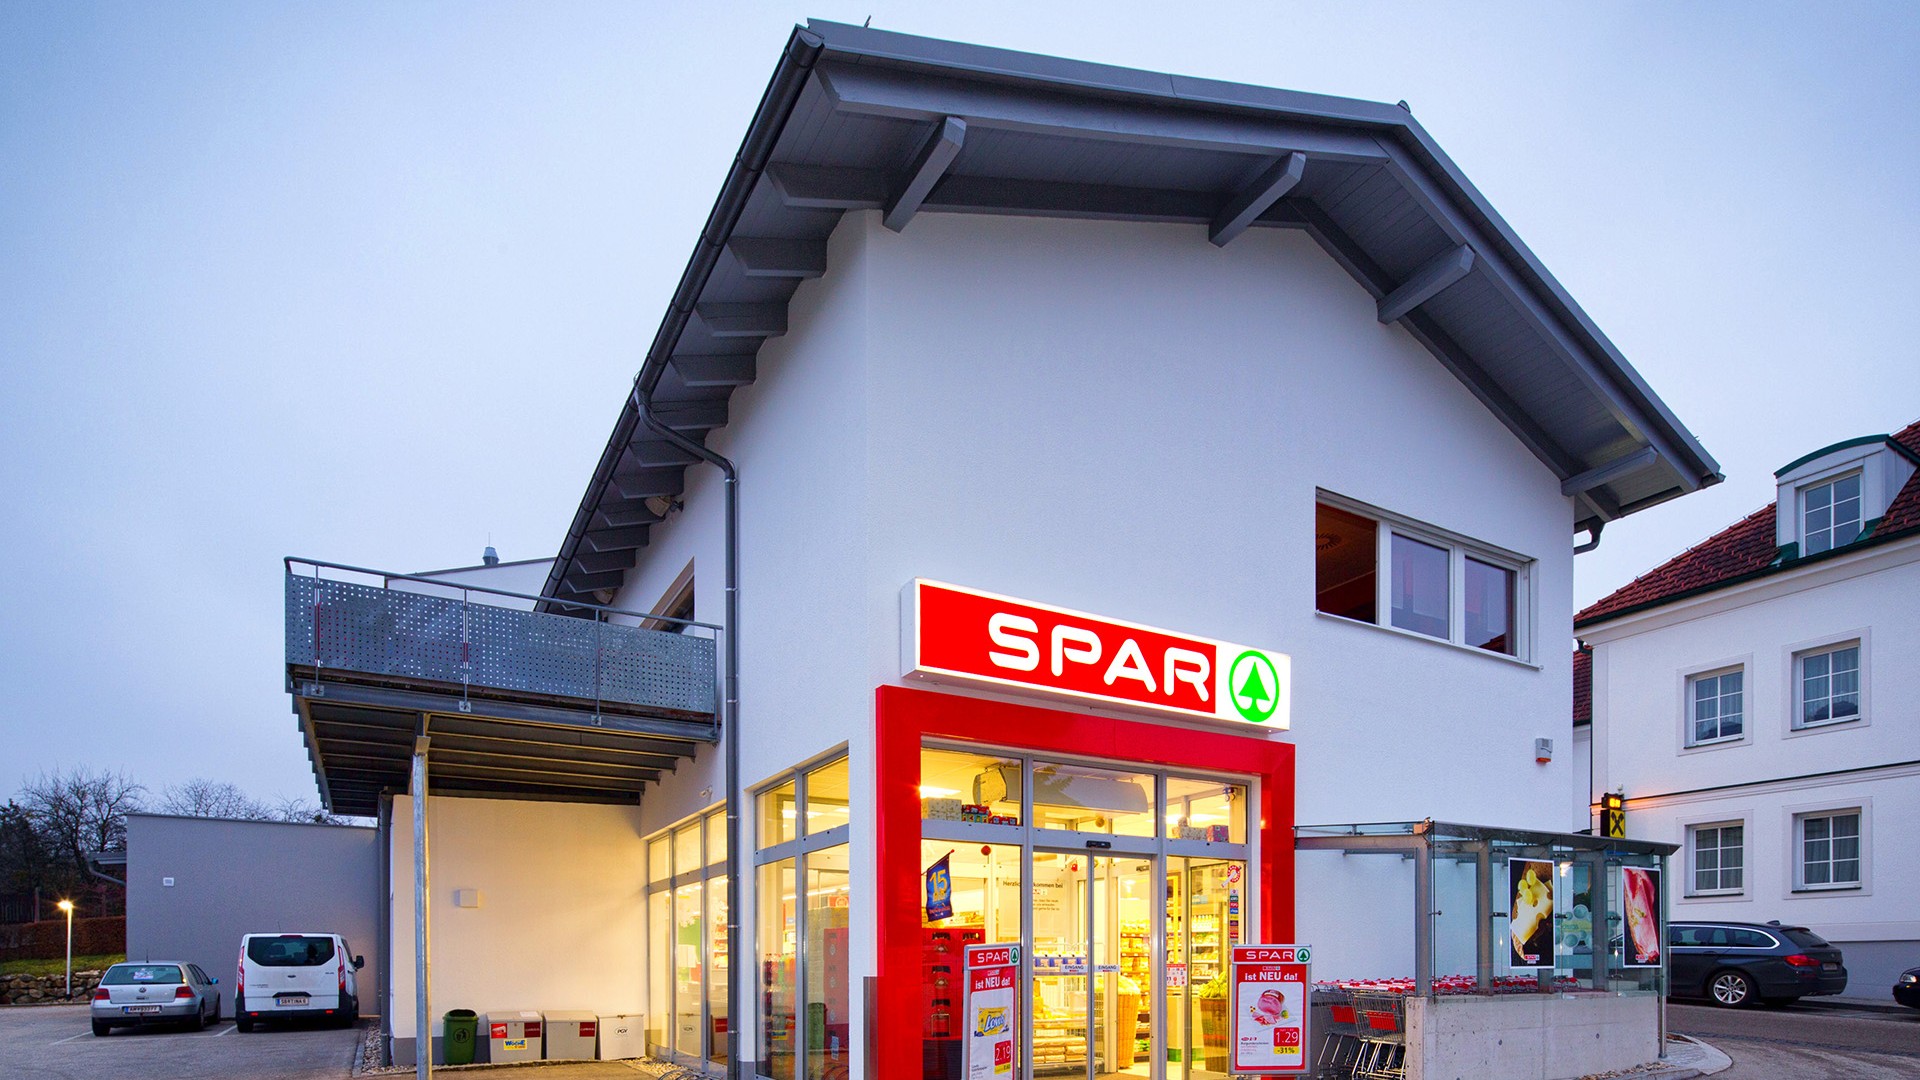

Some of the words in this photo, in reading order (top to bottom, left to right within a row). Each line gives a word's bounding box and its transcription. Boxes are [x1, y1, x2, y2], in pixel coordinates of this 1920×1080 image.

[988, 612, 1210, 702] SPAR
[977, 951, 1009, 963] SPAR
[1246, 951, 1293, 959] SPAR
[1259, 971, 1281, 980] NEU
[975, 980, 984, 989] ist
[985, 976, 1000, 988] NEU
[1001, 977, 1011, 986] da!
[1276, 1032, 1298, 1043] 1.29
[995, 1046, 1011, 1061] 2.19
